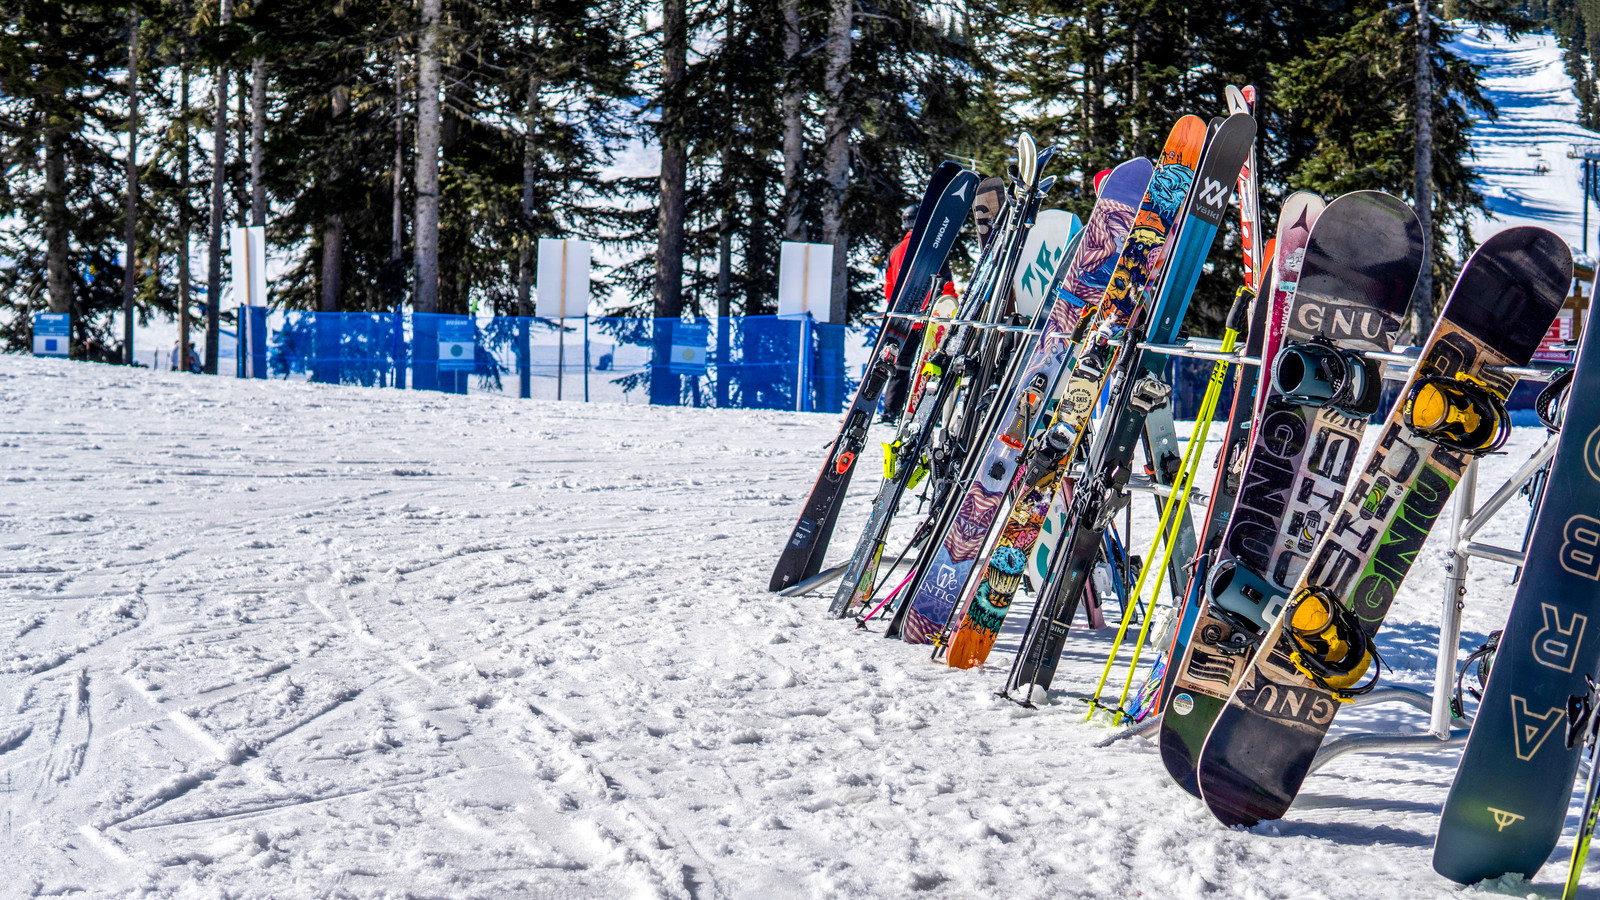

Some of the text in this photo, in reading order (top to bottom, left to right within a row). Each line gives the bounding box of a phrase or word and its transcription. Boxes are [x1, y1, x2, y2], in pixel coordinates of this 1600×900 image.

[932, 216, 951, 249] ATOMIC
[1280, 290, 1294, 334] ATOMIC
[1298, 303, 1384, 339] GNU
[914, 469, 926, 483] LOOK
[1228, 410, 1307, 571] GNU
[1354, 466, 1452, 621] GNU
[1254, 684, 1335, 725] GNU
